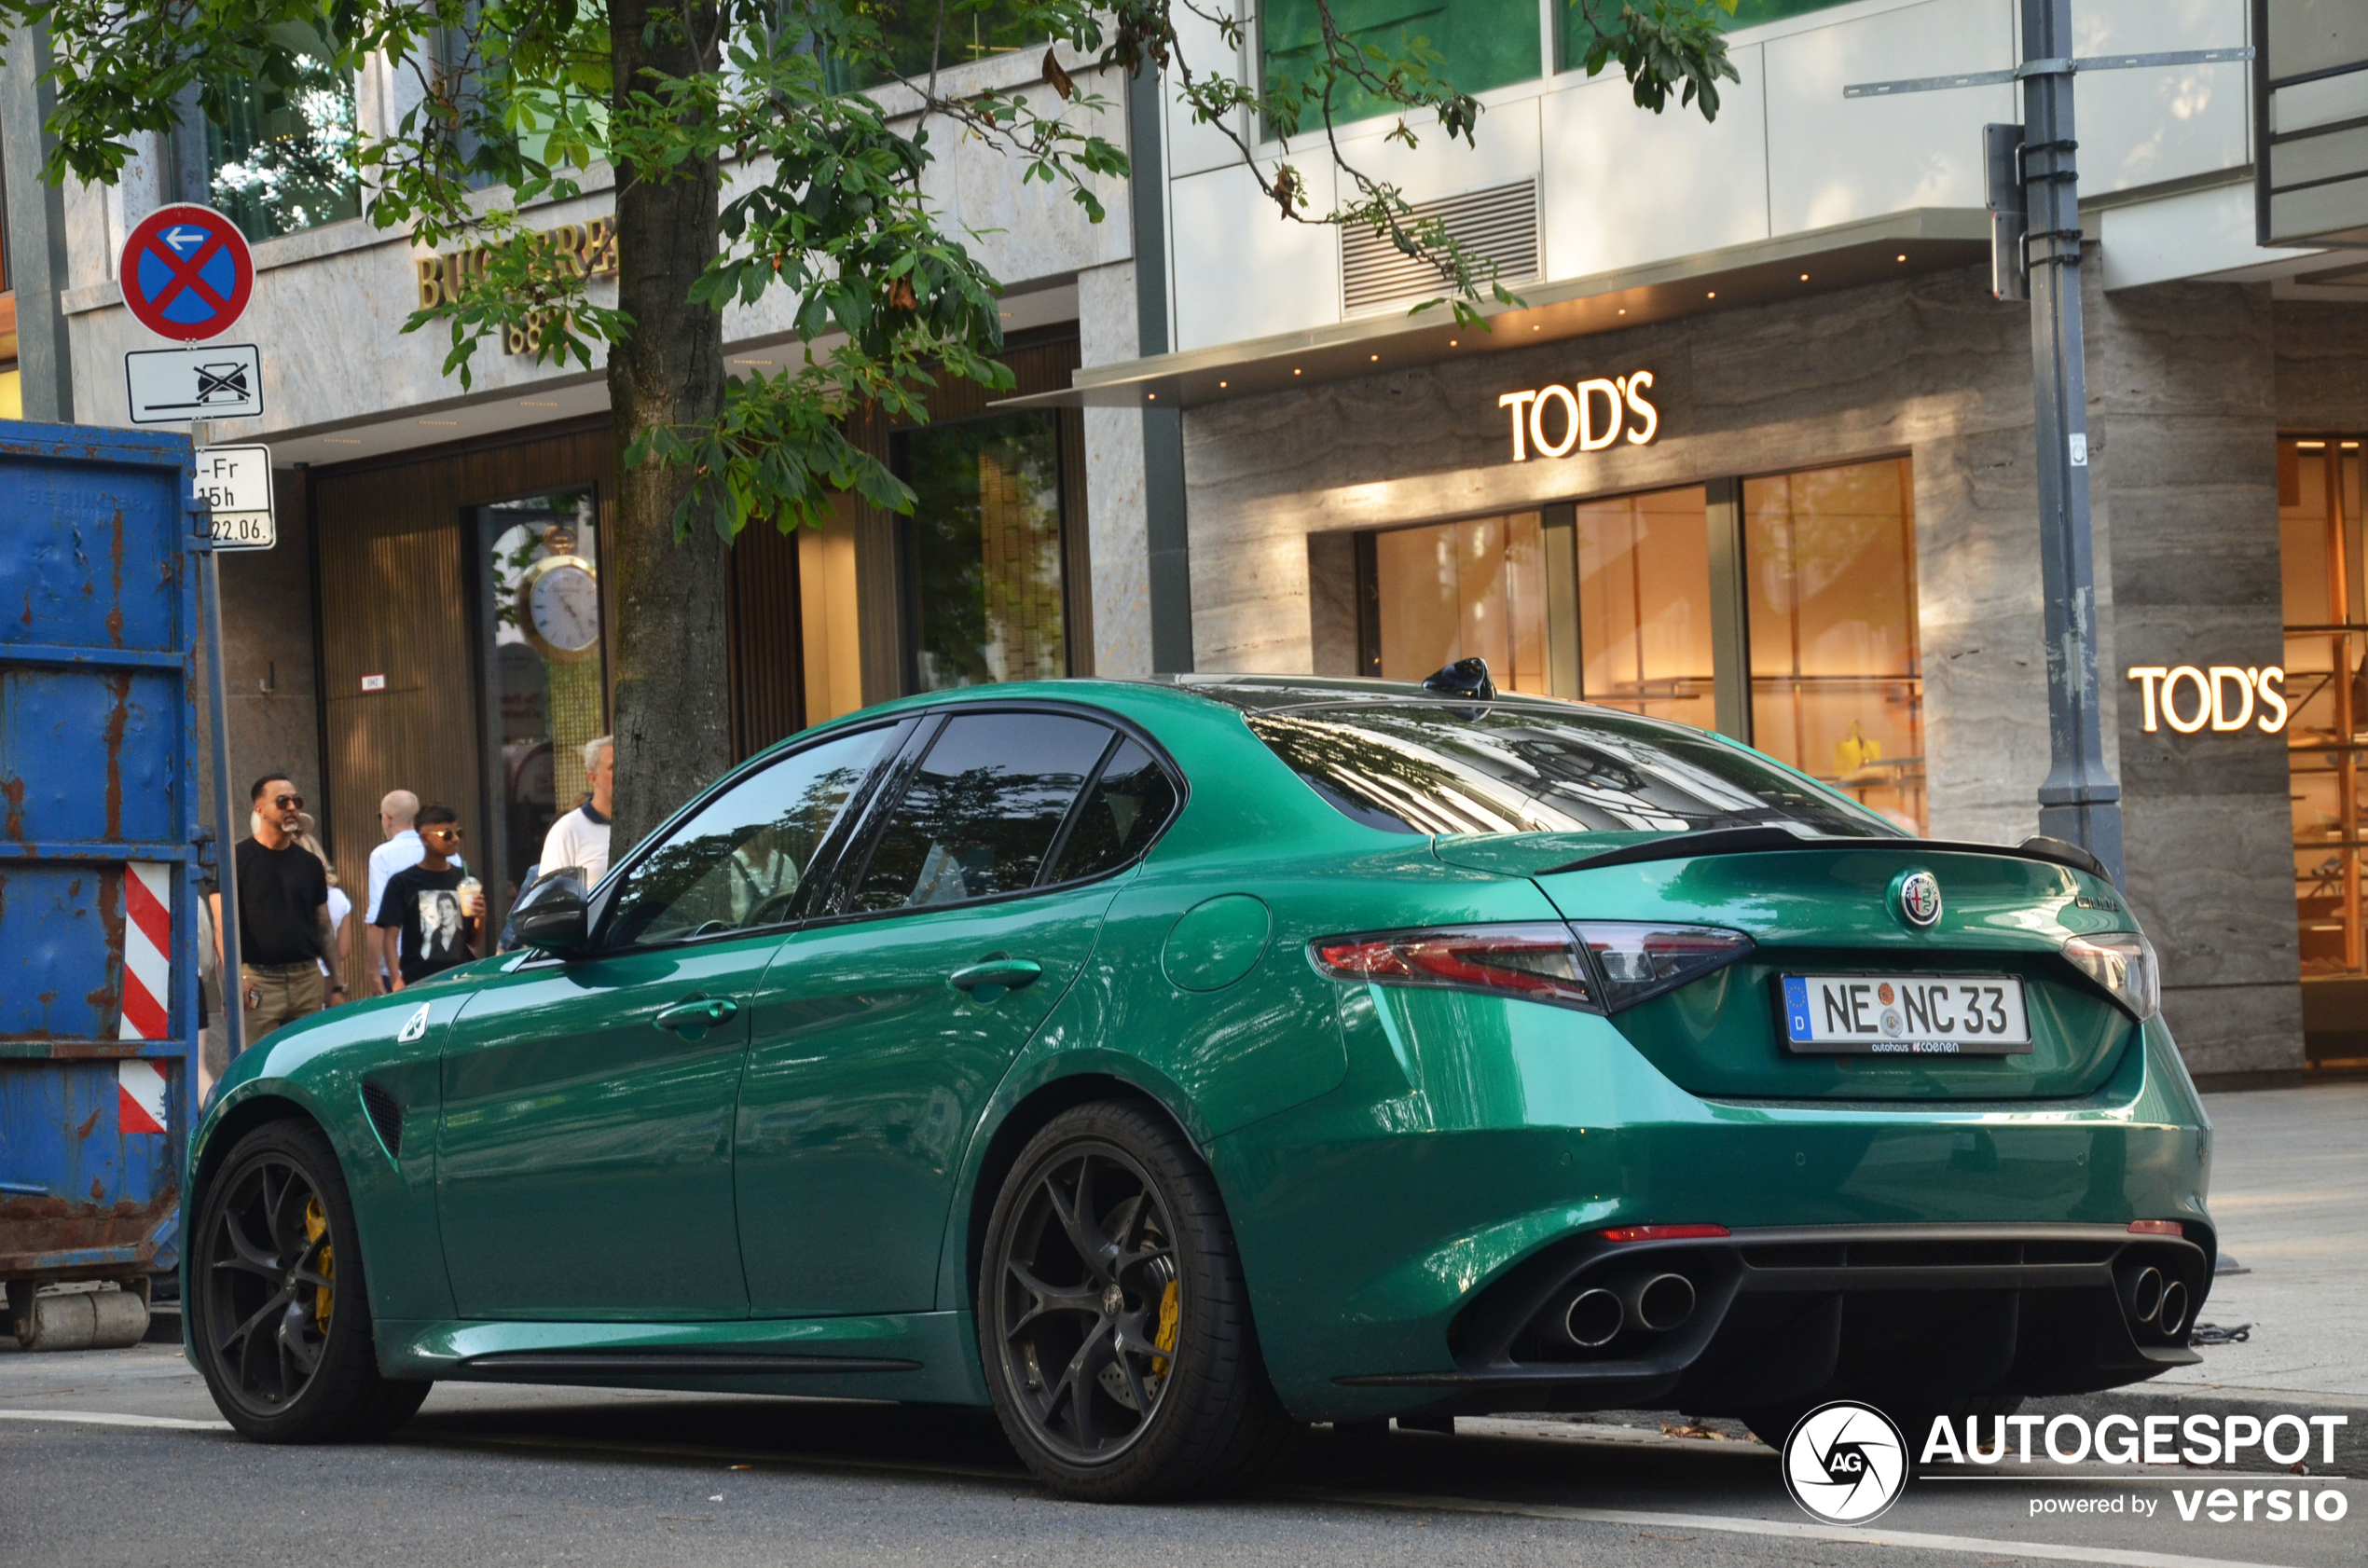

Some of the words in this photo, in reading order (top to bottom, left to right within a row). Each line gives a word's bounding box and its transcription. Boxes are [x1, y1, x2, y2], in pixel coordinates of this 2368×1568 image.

[1499, 370, 1658, 461] TOD'S
[194, 459, 239, 478] -Fr
[2128, 666, 2288, 733] TOD'S
[1795, 1015, 1805, 1031] D
[1823, 984, 1879, 1033] NE
[1902, 984, 1954, 1034] NC
[1960, 986, 2007, 1035] 33
[1872, 1041, 1909, 1052] autohaus
